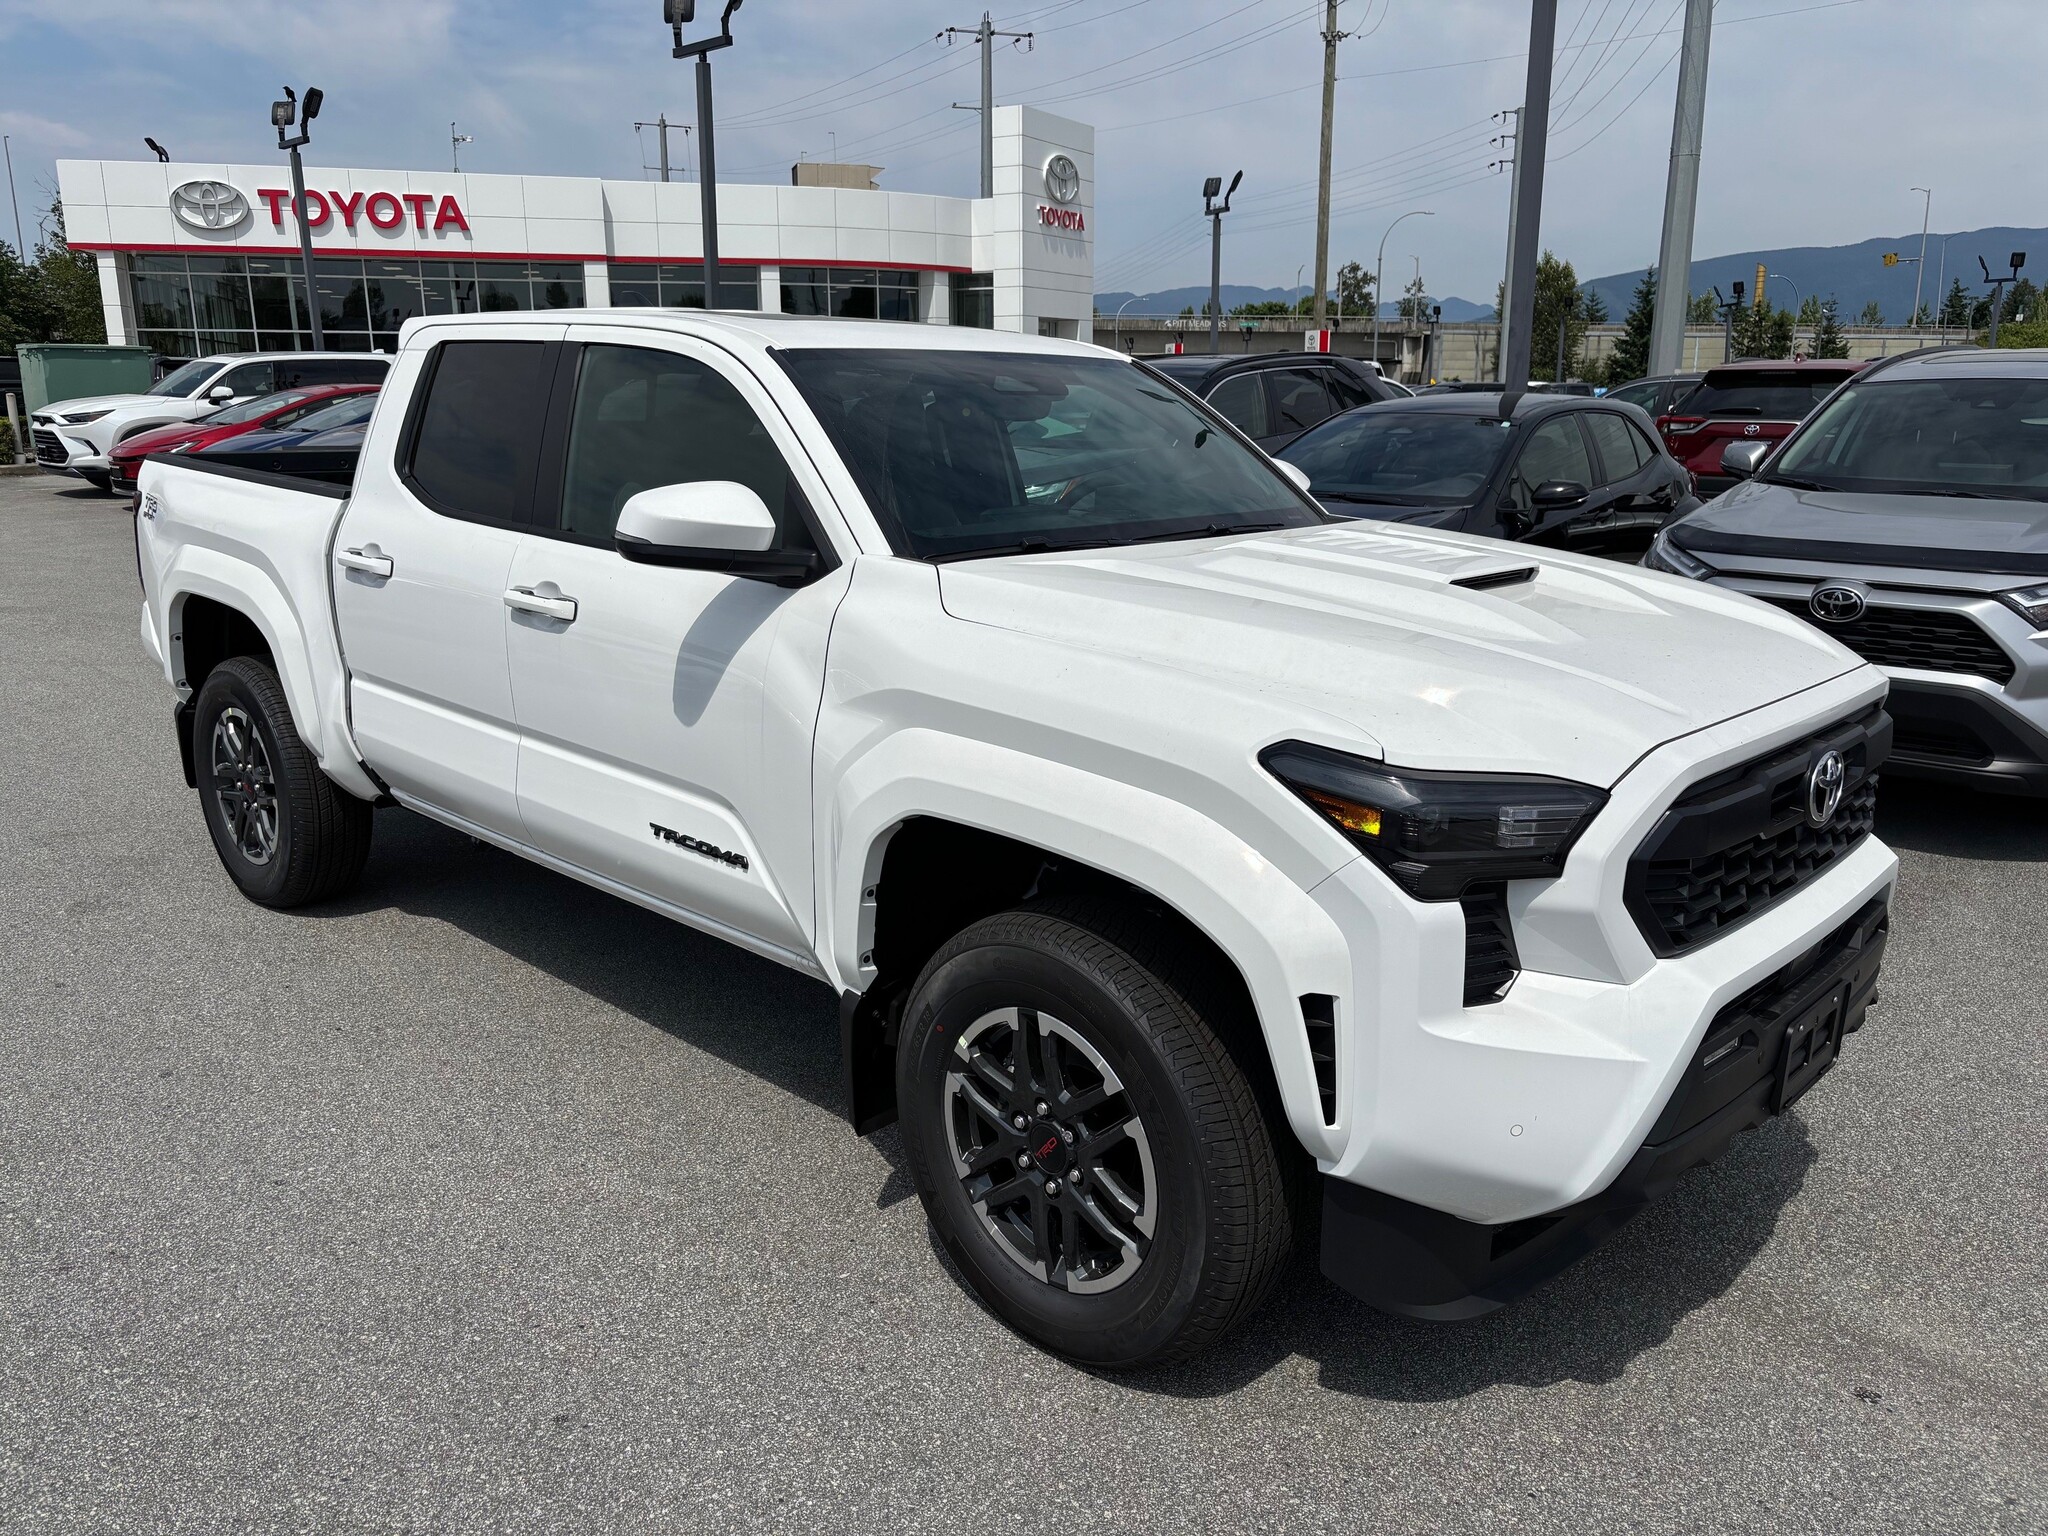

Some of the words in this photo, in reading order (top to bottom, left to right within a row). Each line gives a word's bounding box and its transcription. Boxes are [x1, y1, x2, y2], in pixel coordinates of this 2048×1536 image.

[257, 189, 470, 230] TOYOTA
[1037, 203, 1085, 232] TOYOTA
[1172, 320, 1187, 328] PITT
[1189, 320, 1227, 328] MEADS
[649, 822, 750, 871] TACOMA
[1034, 1136, 1058, 1159] TRD
